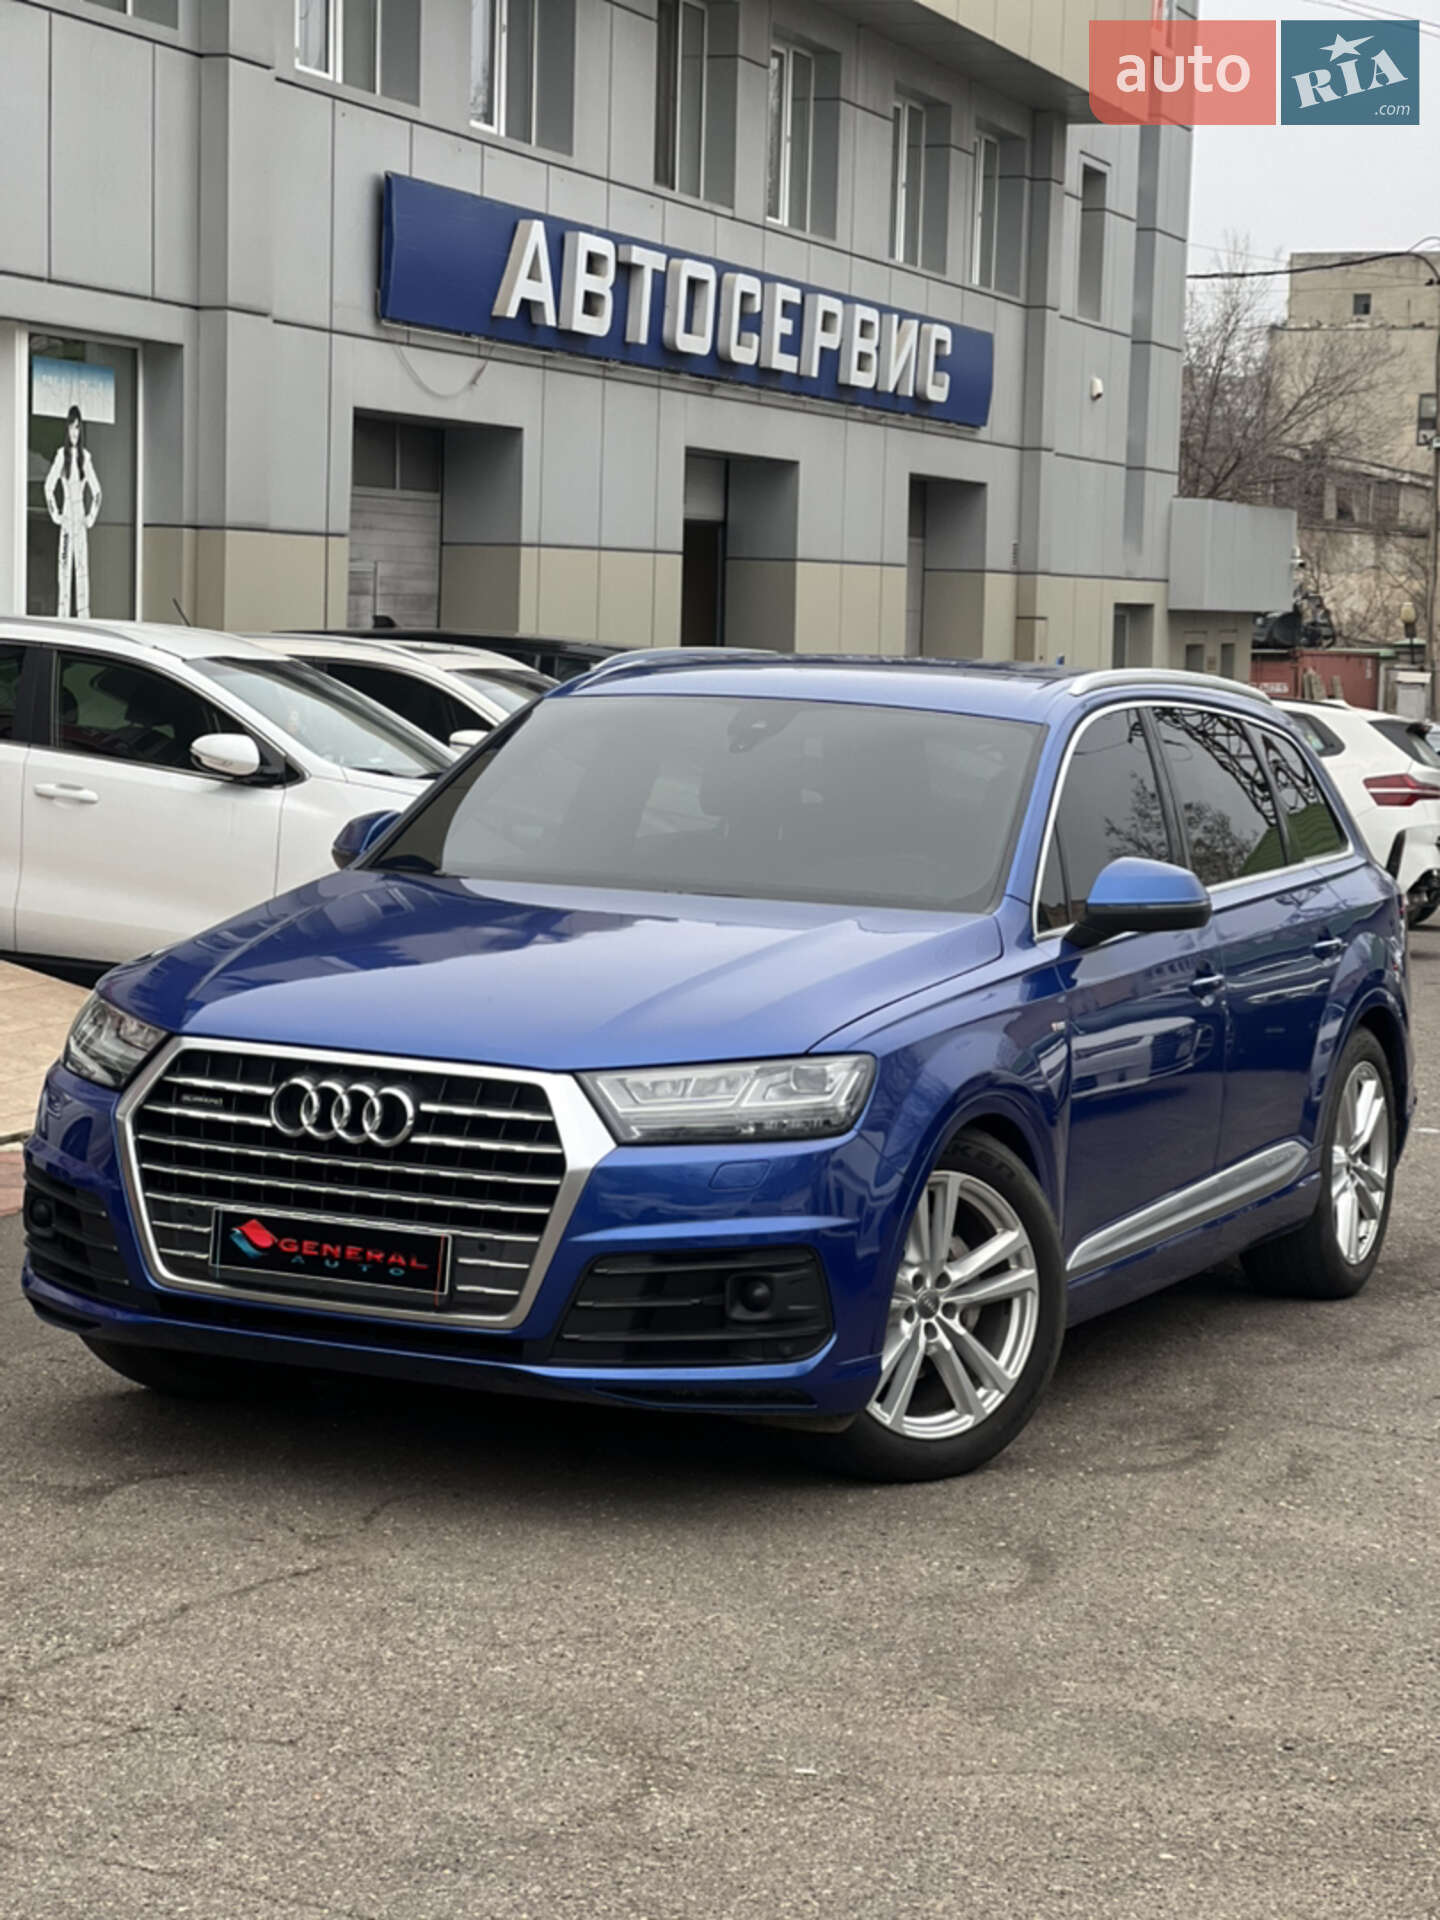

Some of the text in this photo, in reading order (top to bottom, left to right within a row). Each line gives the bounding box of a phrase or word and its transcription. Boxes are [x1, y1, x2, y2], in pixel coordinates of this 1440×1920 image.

[492, 219, 952, 402] АВТОСЕРВИС
[278, 1238, 429, 1270] GENERAL
[290, 1255, 406, 1277] AUTO
